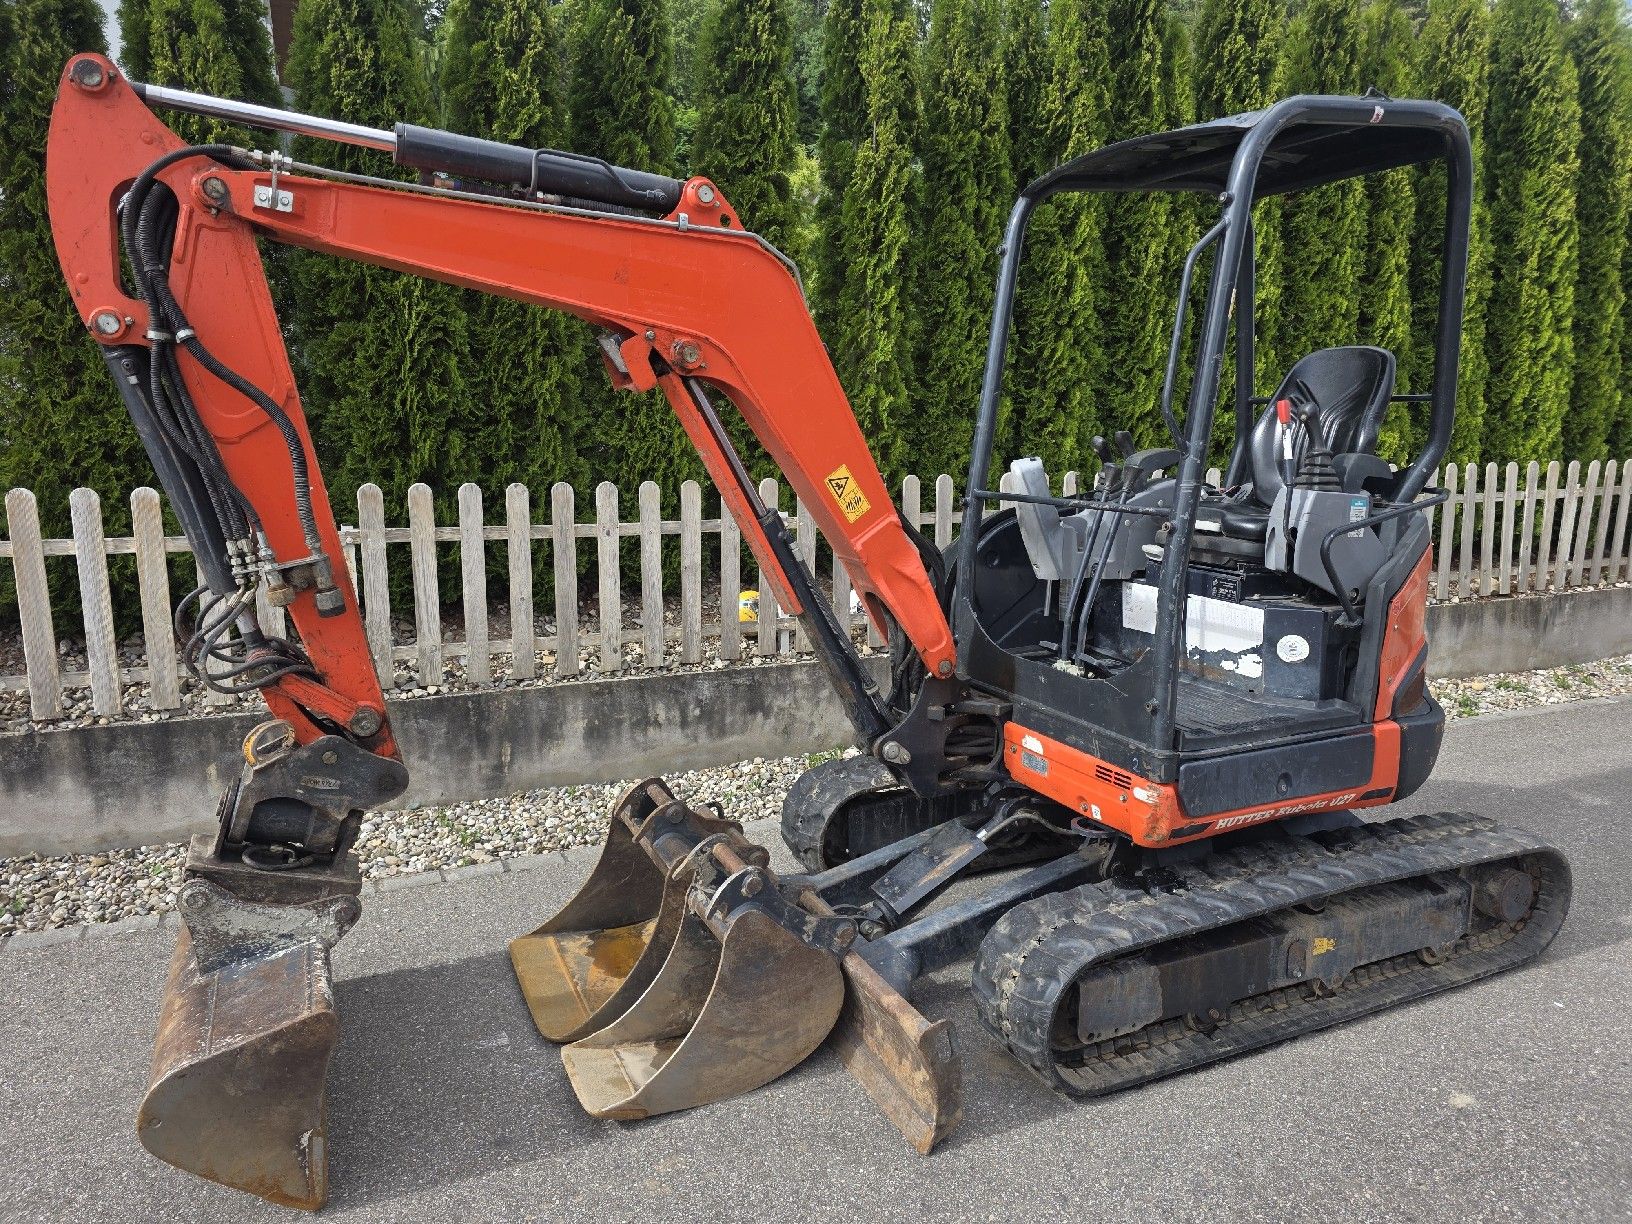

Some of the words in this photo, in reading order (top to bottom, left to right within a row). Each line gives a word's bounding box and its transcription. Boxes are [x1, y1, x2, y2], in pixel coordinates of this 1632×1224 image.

[1215, 809, 1275, 830] HUTTER
[1275, 800, 1328, 817] Kubota
[1329, 793, 1356, 807] U27
